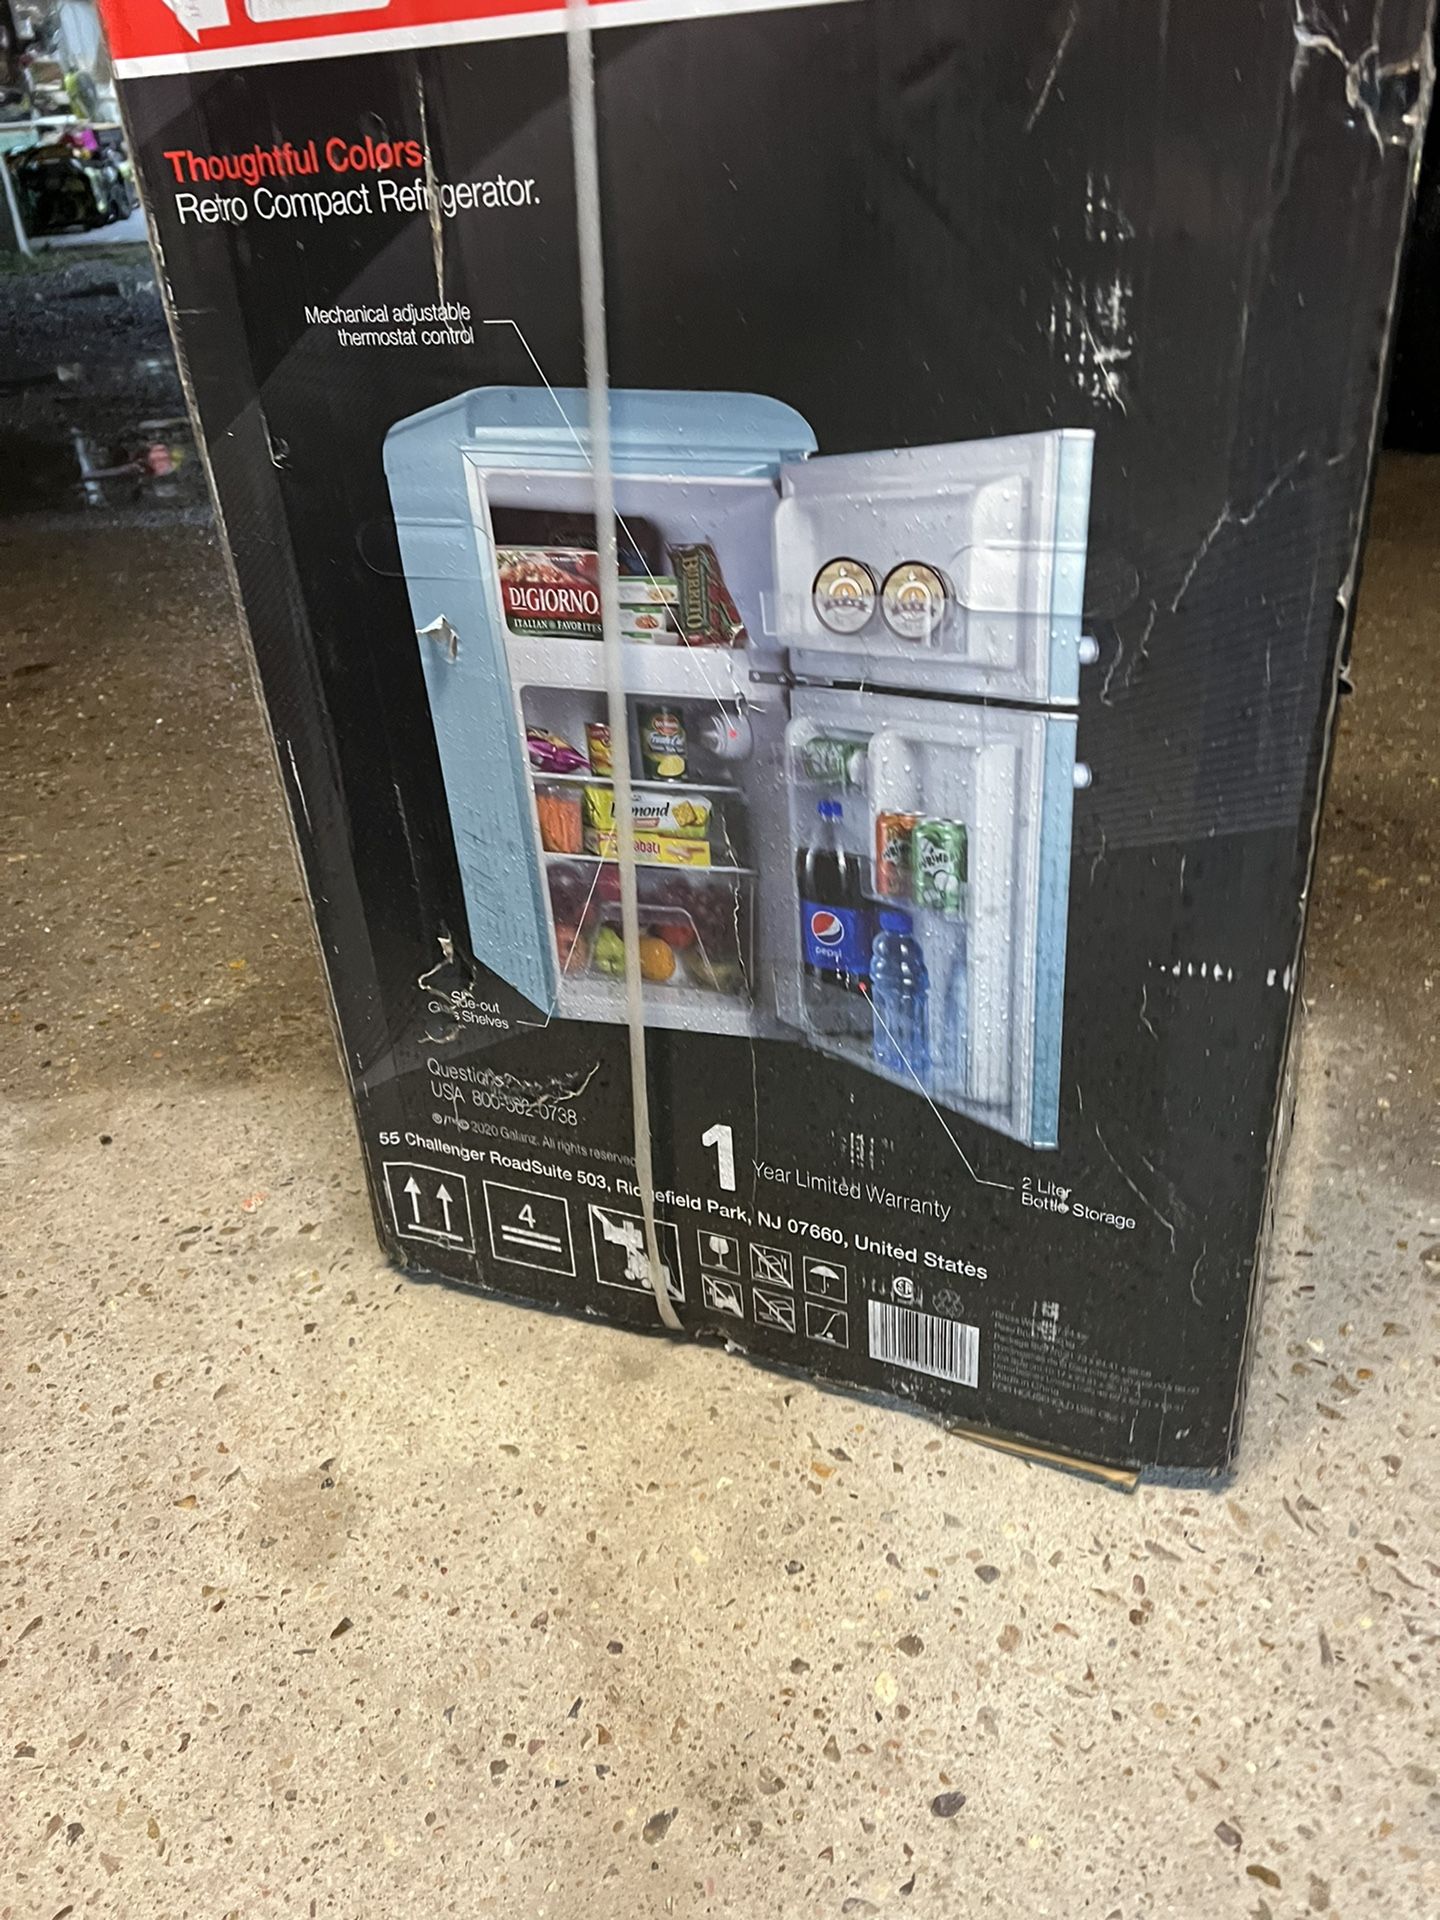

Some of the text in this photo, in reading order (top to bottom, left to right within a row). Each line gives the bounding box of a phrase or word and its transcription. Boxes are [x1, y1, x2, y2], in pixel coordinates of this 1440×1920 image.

[163, 140, 320, 186] Thoughtful
[175, 174, 541, 225] Retro Compact Refrgerator.
[304, 300, 471, 326] Mechanical adjustable
[337, 325, 474, 346] thermostat control
[513, 617, 549, 630] ITALIAN
[557, 620, 603, 633] FAVORITES
[461, 1010, 510, 1030] Shelves
[430, 1079, 467, 1105] USA
[470, 1120, 499, 1137] 2020
[542, 1135, 558, 1148] All
[558, 1138, 588, 1157] rights
[702, 1122, 736, 1193] 1
[752, 1159, 952, 1223] Year Limited Warranty
[1022, 1176, 1073, 1199] 2 Liter
[379, 1131, 401, 1146] 55
[404, 1131, 486, 1162] Challenger
[489, 1150, 573, 1183] RoadSuite
[576, 1169, 612, 1193] 503,
[706, 1199, 752, 1226] Park,
[757, 1210, 782, 1231] NJ
[787, 1221, 849, 1249] 07660,
[854, 1234, 918, 1265] United
[923, 1251, 989, 1280] States
[518, 1204, 537, 1229] 4
[1021, 1192, 1136, 1230] Bottle Storage
